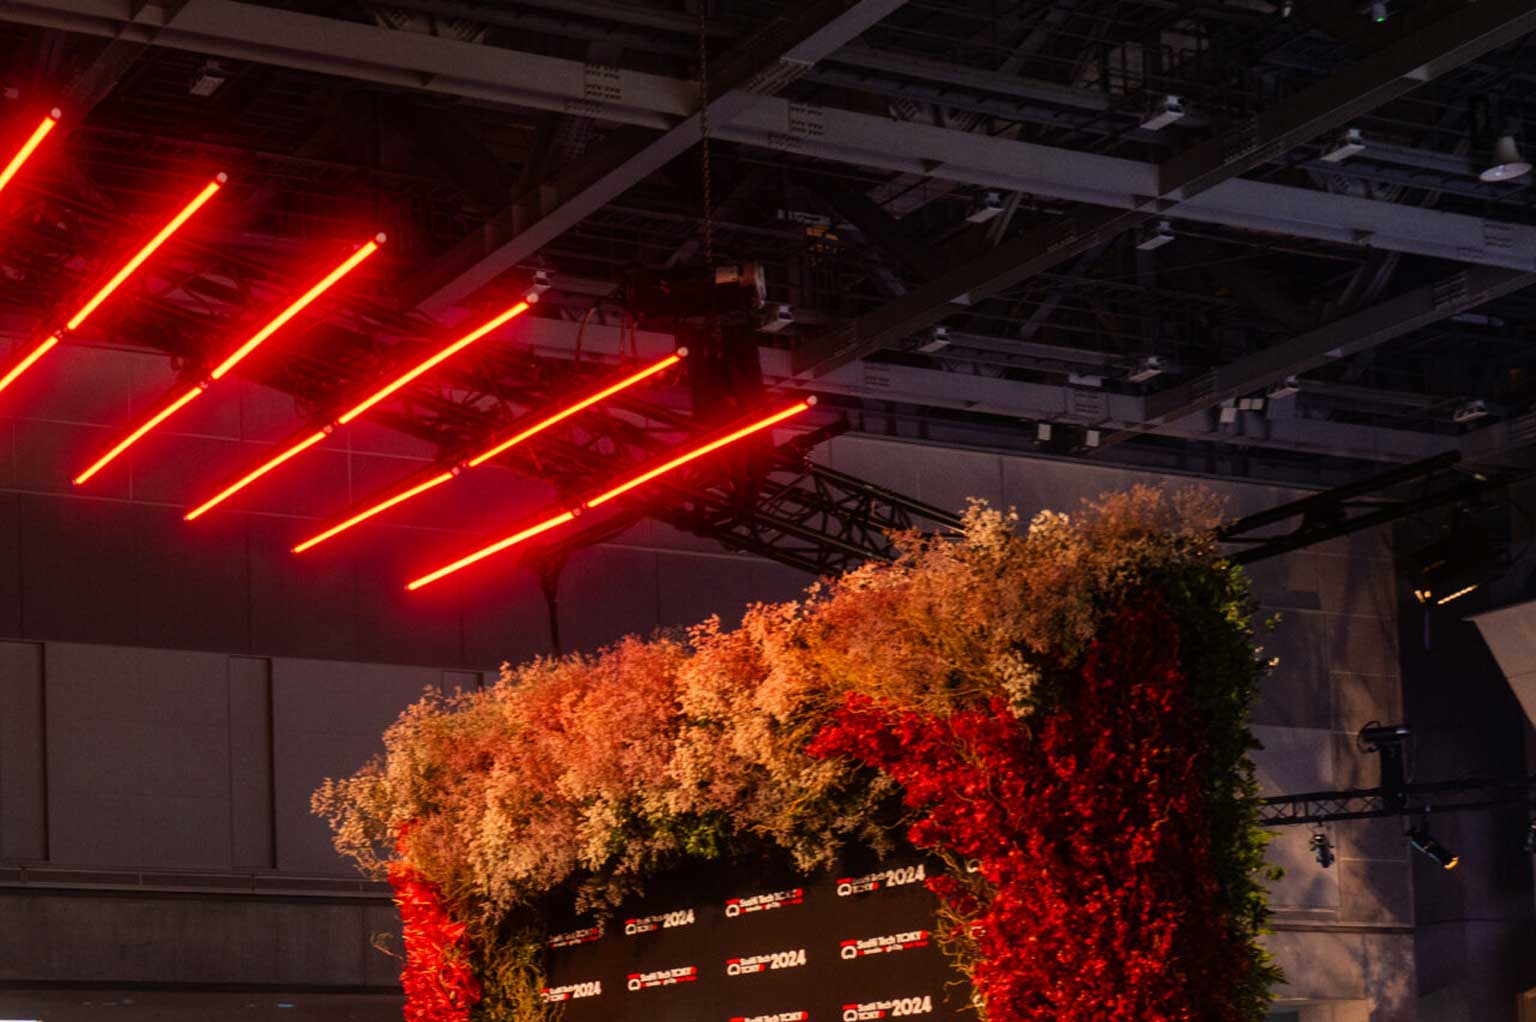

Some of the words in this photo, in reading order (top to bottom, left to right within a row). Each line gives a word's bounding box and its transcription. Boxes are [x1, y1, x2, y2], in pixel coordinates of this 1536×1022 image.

[885, 865, 925, 887] 2024
[663, 908, 695, 928] 2024
[771, 949, 806, 969] 2024
[573, 981, 601, 998] 2024
[892, 996, 933, 1016] 2024
